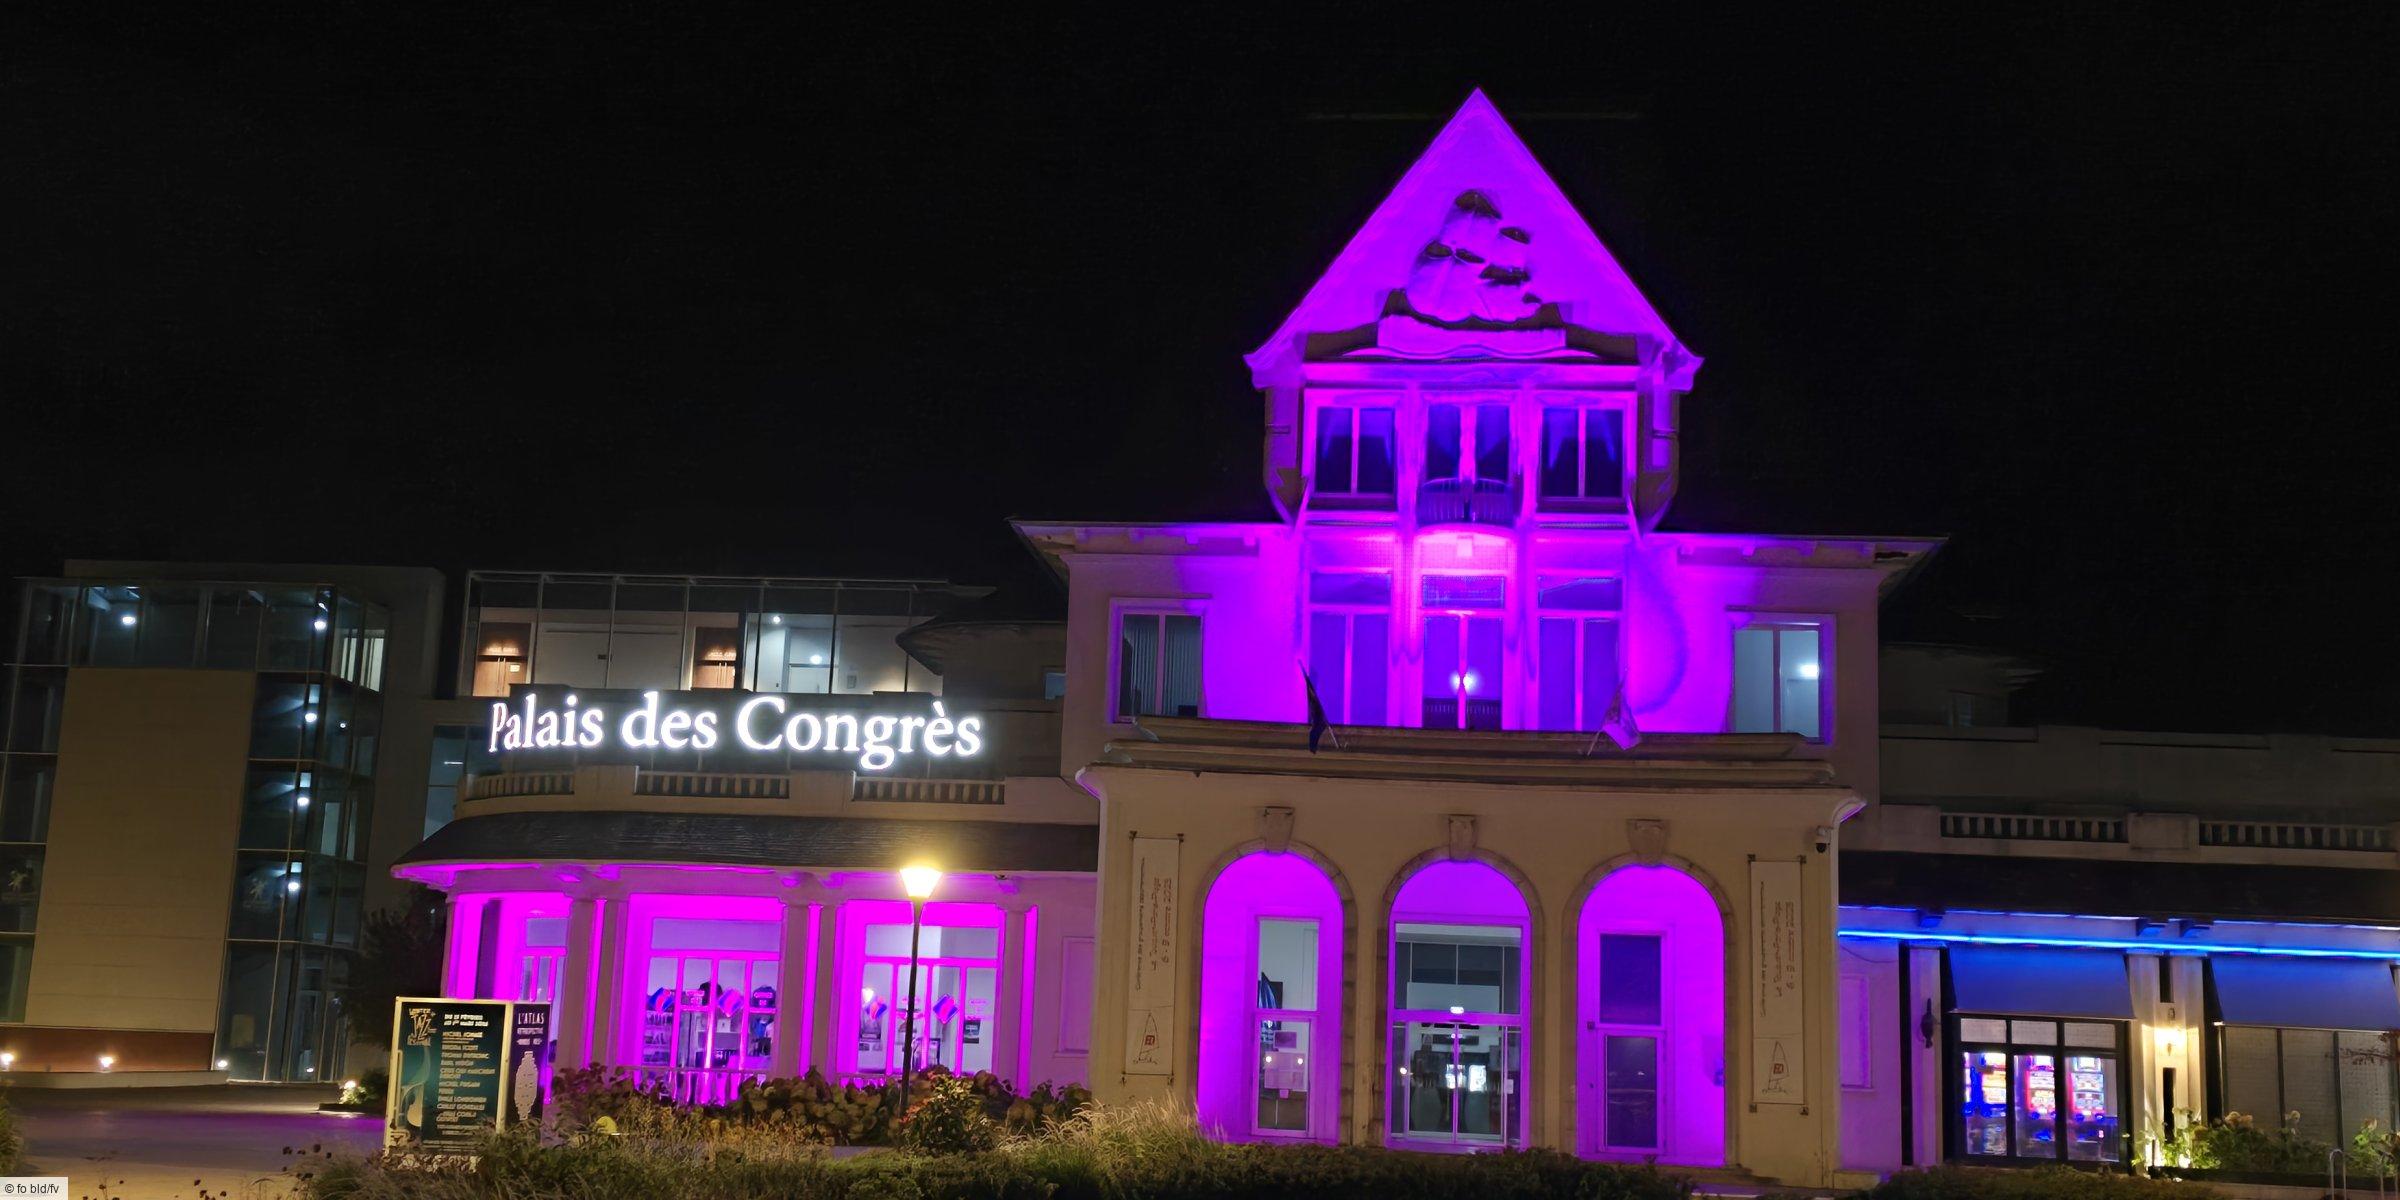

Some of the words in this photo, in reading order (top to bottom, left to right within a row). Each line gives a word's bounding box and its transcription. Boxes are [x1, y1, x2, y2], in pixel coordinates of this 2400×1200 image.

[488, 693, 604, 753] Palais
[621, 691, 719, 750] des
[737, 696, 982, 770] Congrès
